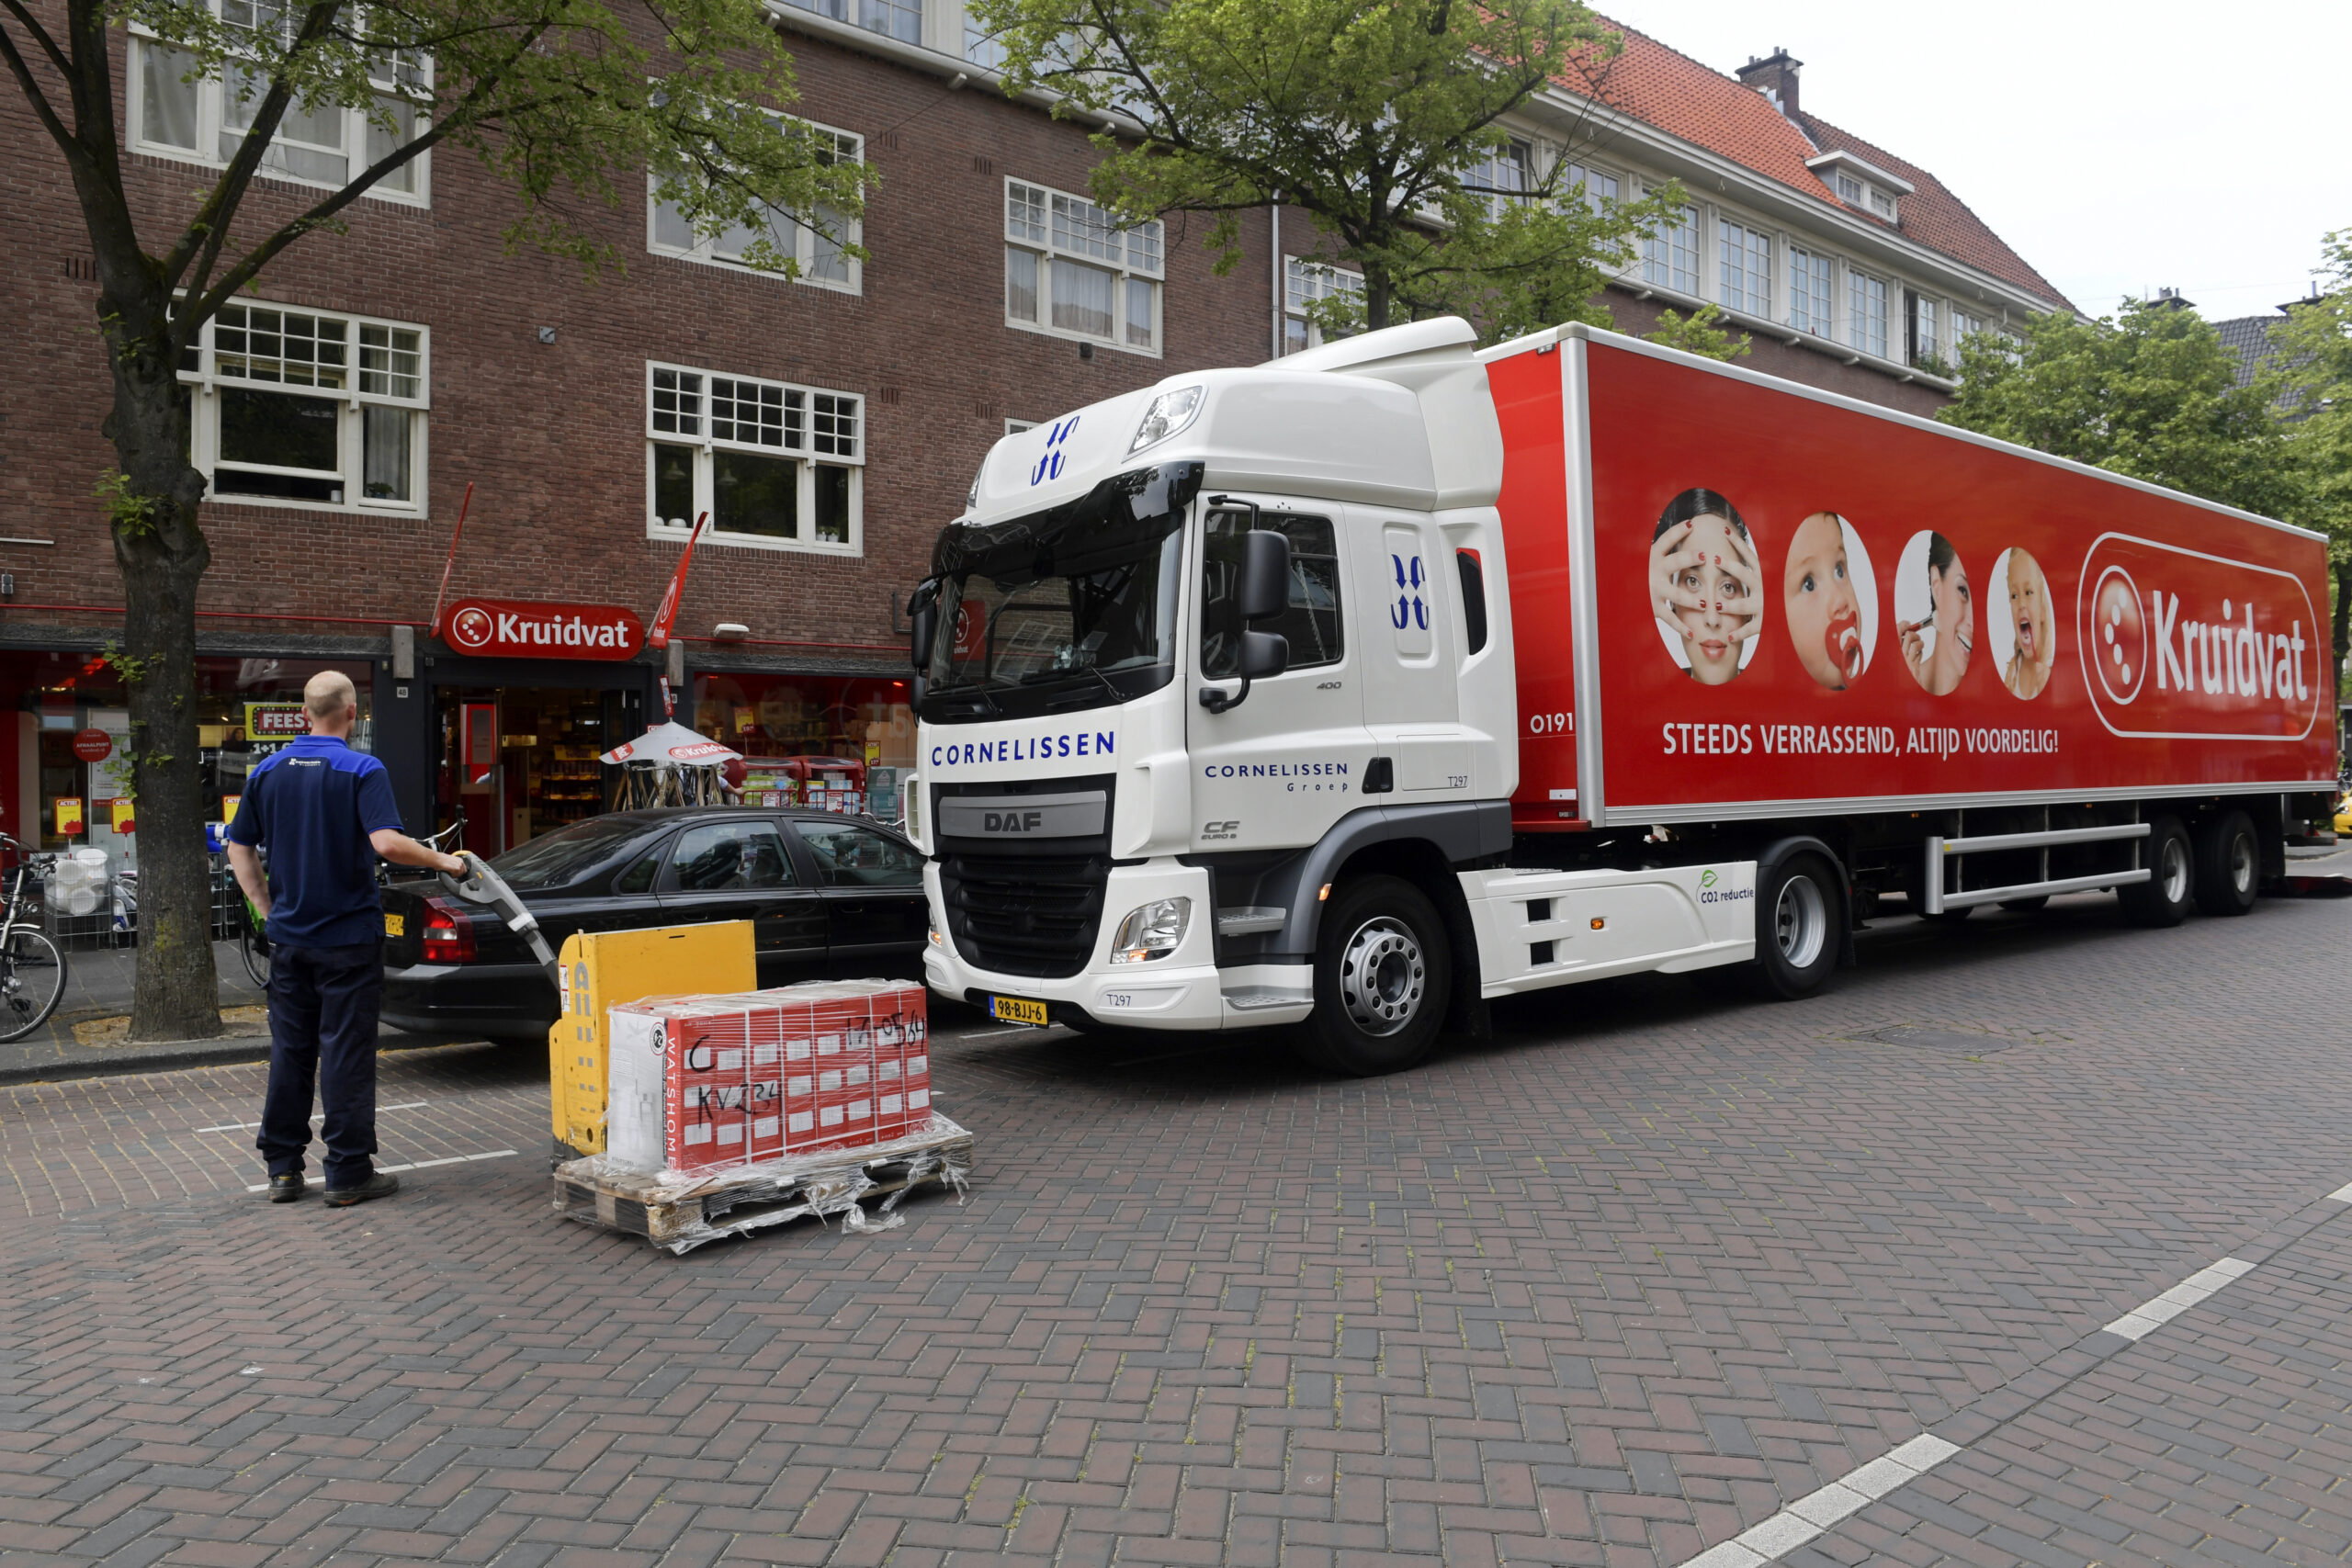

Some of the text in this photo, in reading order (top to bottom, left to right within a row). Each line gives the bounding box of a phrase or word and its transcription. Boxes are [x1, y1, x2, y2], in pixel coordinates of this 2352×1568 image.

[498, 613, 629, 648] Kruidvat
[2153, 590, 2308, 701] Kruidvat
[1317, 682, 1342, 690] 400
[1530, 713, 1574, 733] 0191
[932, 731, 1114, 766] CORNELISSEN
[1663, 722, 2059, 761] STEEDS VERRASSEND, ALTIJD VOORDELIG!
[1204, 763, 1348, 778] CORNELISSEN
[1287, 783, 1348, 793] Groep
[1448, 775, 1468, 788] T297
[984, 812, 1042, 832] DAF
[1204, 821, 1239, 833] CF
[1701, 886, 1754, 903] CO2 reductie
[998, 1000, 1043, 1021] 98-BJJ-6
[1106, 994, 1132, 1007] T297
[666, 1037, 676, 1169] WATSHOME
